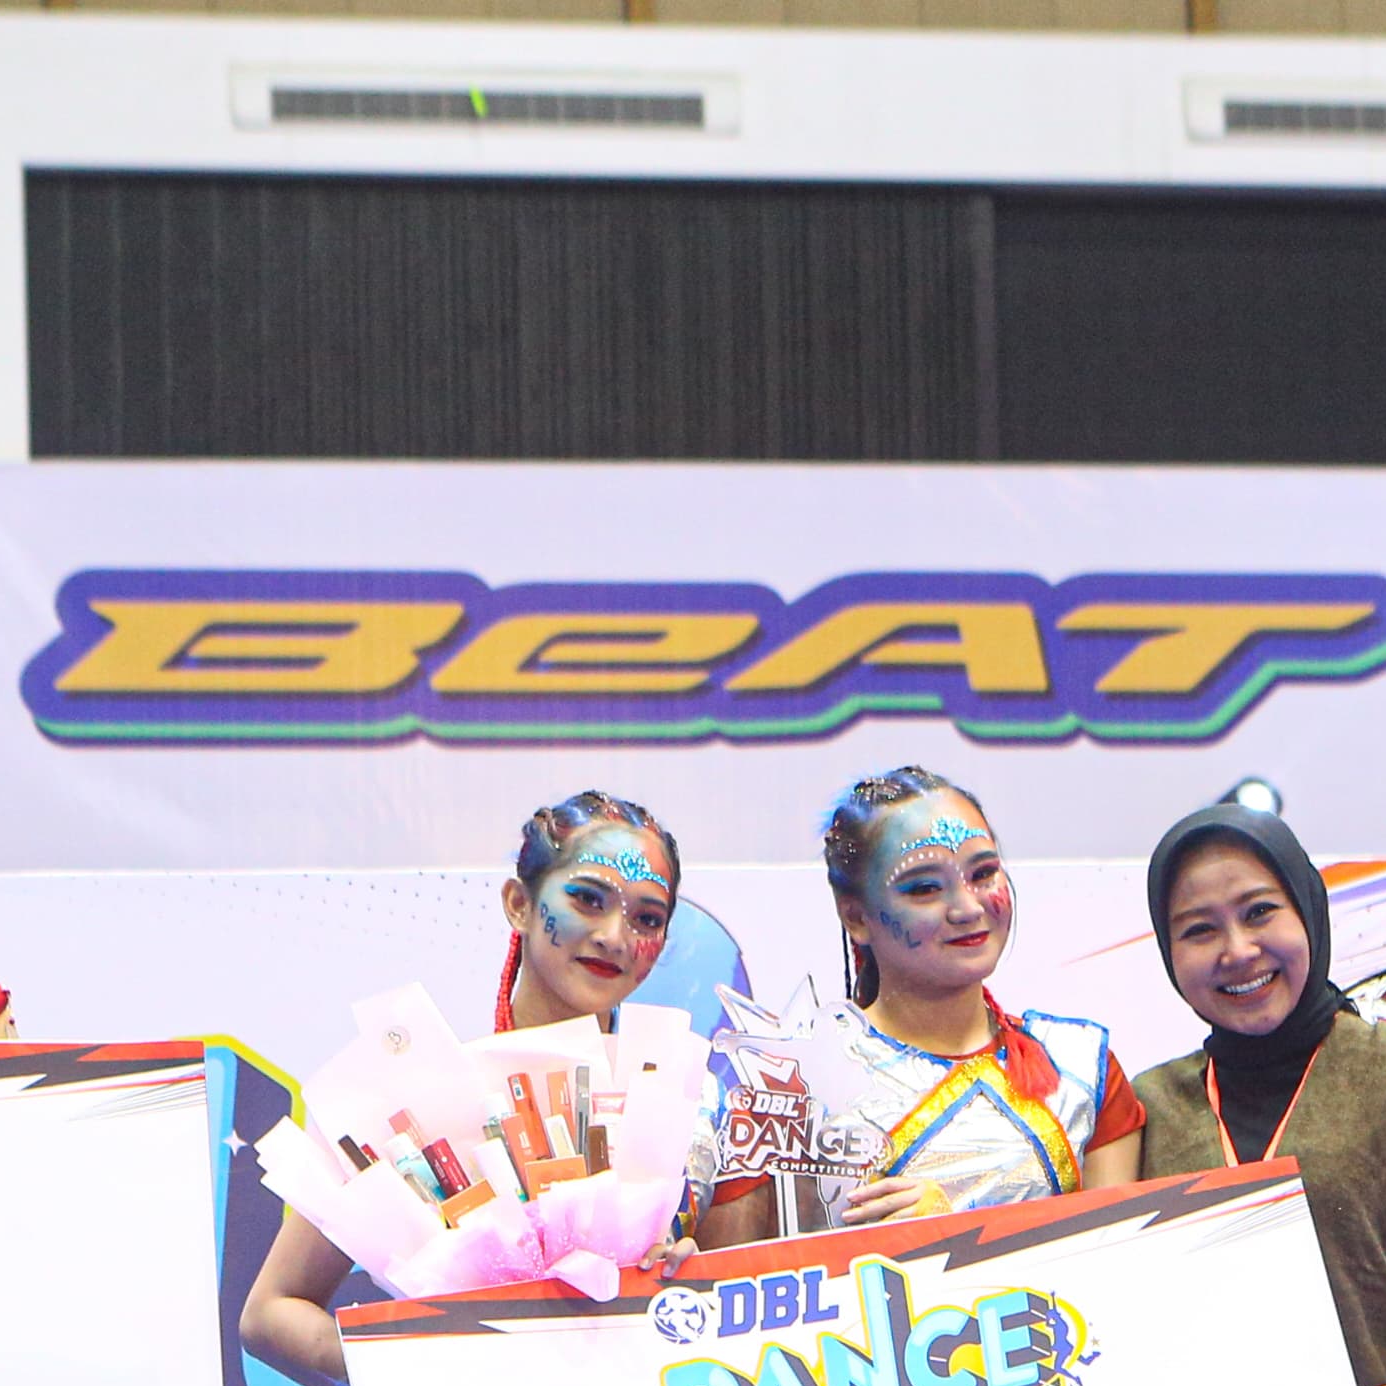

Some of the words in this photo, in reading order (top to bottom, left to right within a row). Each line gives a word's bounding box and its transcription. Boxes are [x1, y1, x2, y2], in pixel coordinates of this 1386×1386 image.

[751, 1092, 801, 1118] DBL
[728, 1100, 867, 1163] DANCE
[770, 1160, 867, 1178] COMPETITION
[716, 1270, 840, 1338] DBL
